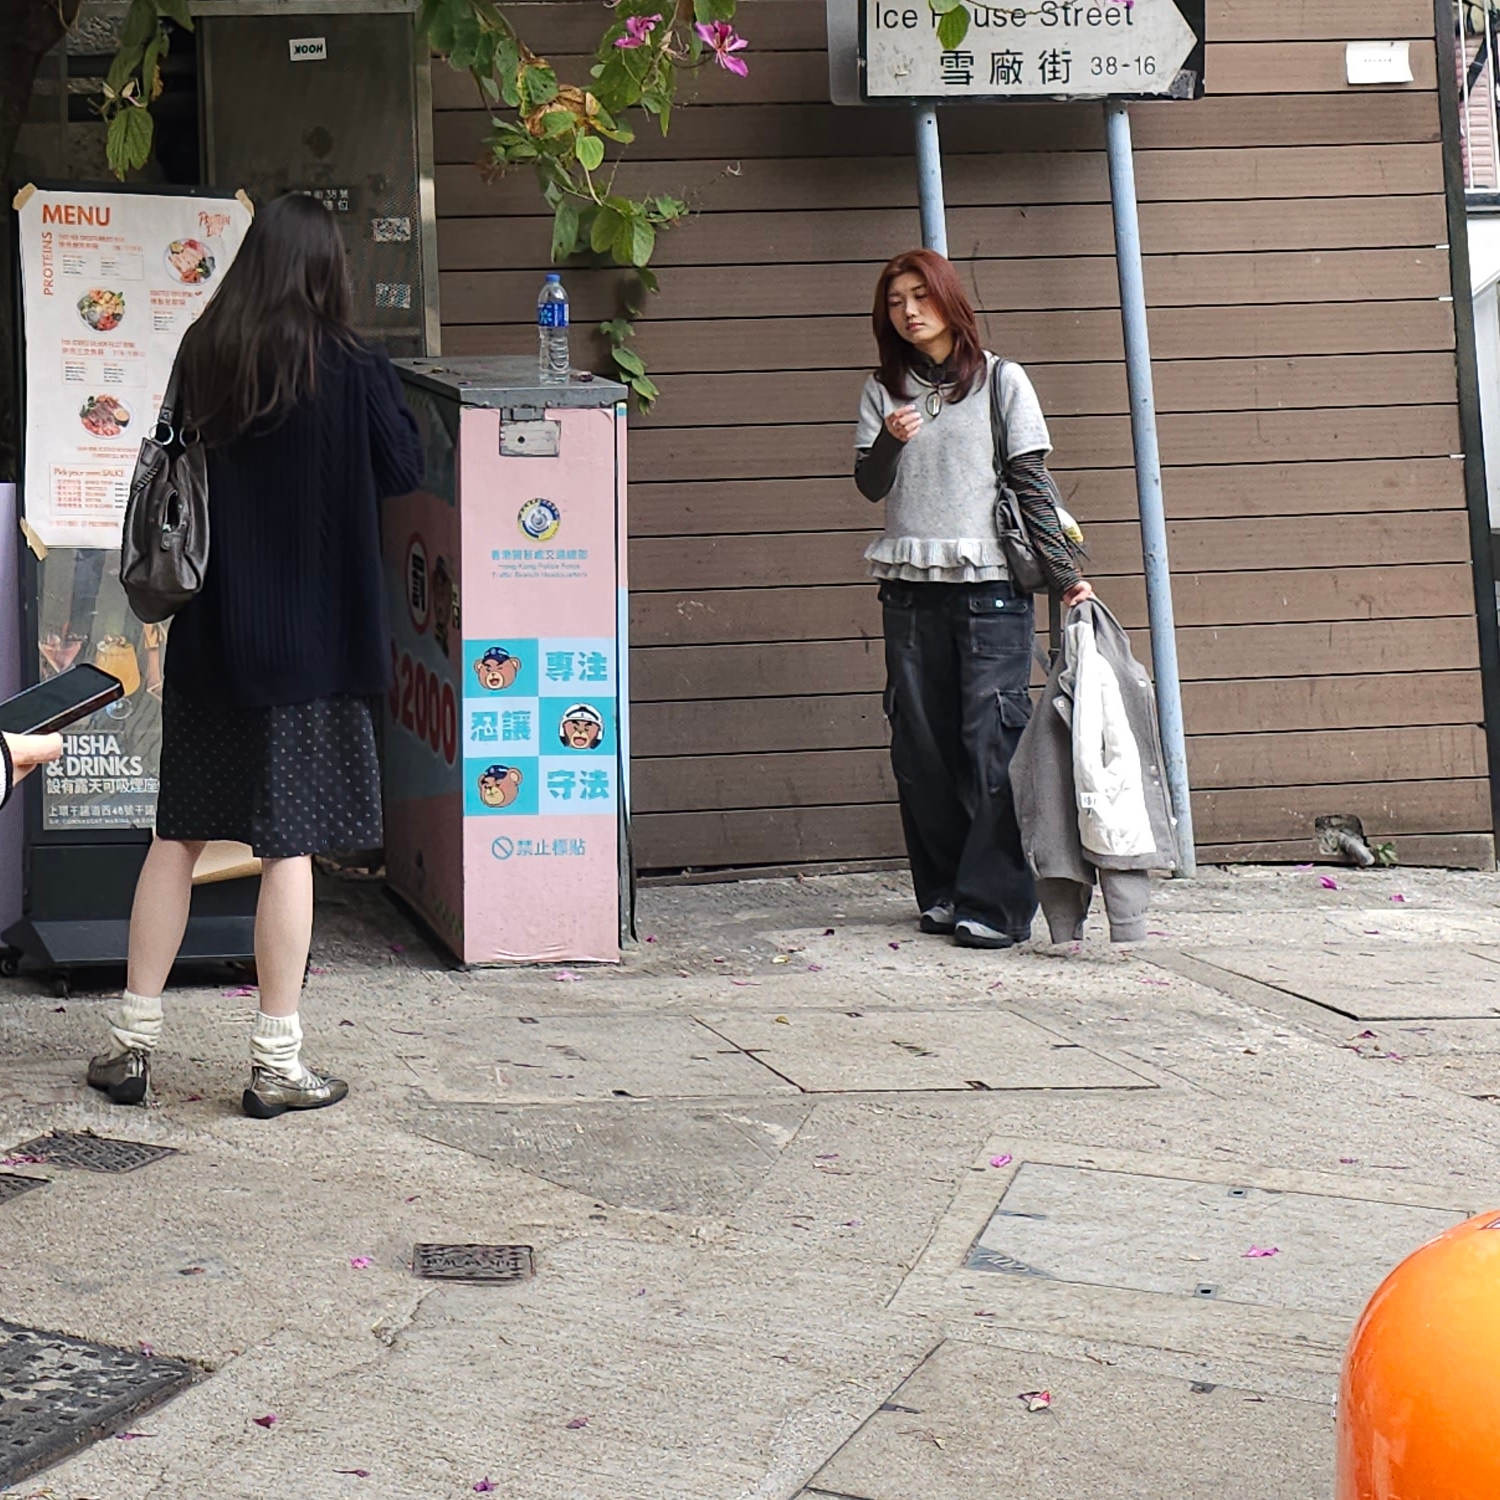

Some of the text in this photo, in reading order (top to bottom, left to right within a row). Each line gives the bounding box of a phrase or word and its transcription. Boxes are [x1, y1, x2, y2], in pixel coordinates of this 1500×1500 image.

[875, 0, 1134, 29] Ice use Street
[939, 49, 1157, 86] 雪廠街 38-16
[41, 204, 110, 227] MENU
[41, 231, 54, 296] PROTEINS
[545, 651, 608, 682] 專注
[470, 710, 531, 741] 忍讓
[60, 734, 122, 755] HISHA
[46, 755, 143, 777] & DRINKS
[547, 769, 610, 800] 守法
